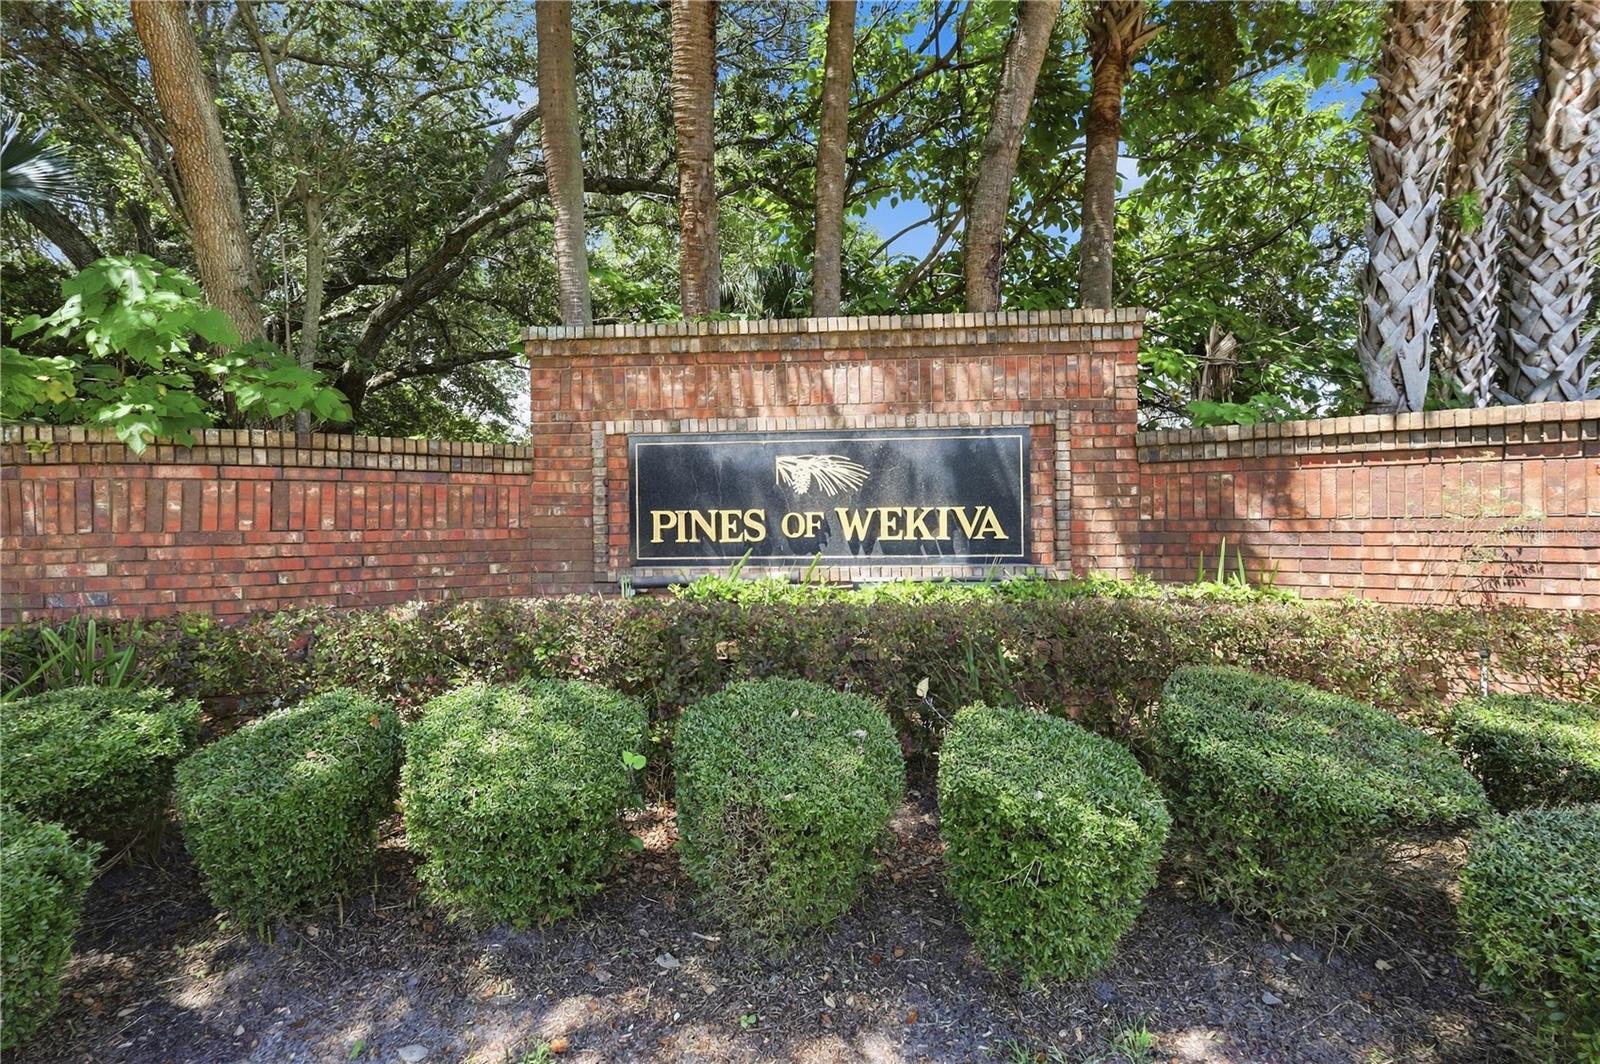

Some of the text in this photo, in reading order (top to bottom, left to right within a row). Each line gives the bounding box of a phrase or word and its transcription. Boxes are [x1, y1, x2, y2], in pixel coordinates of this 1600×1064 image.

[650, 506, 1009, 543] PINES OF WEKIVA
